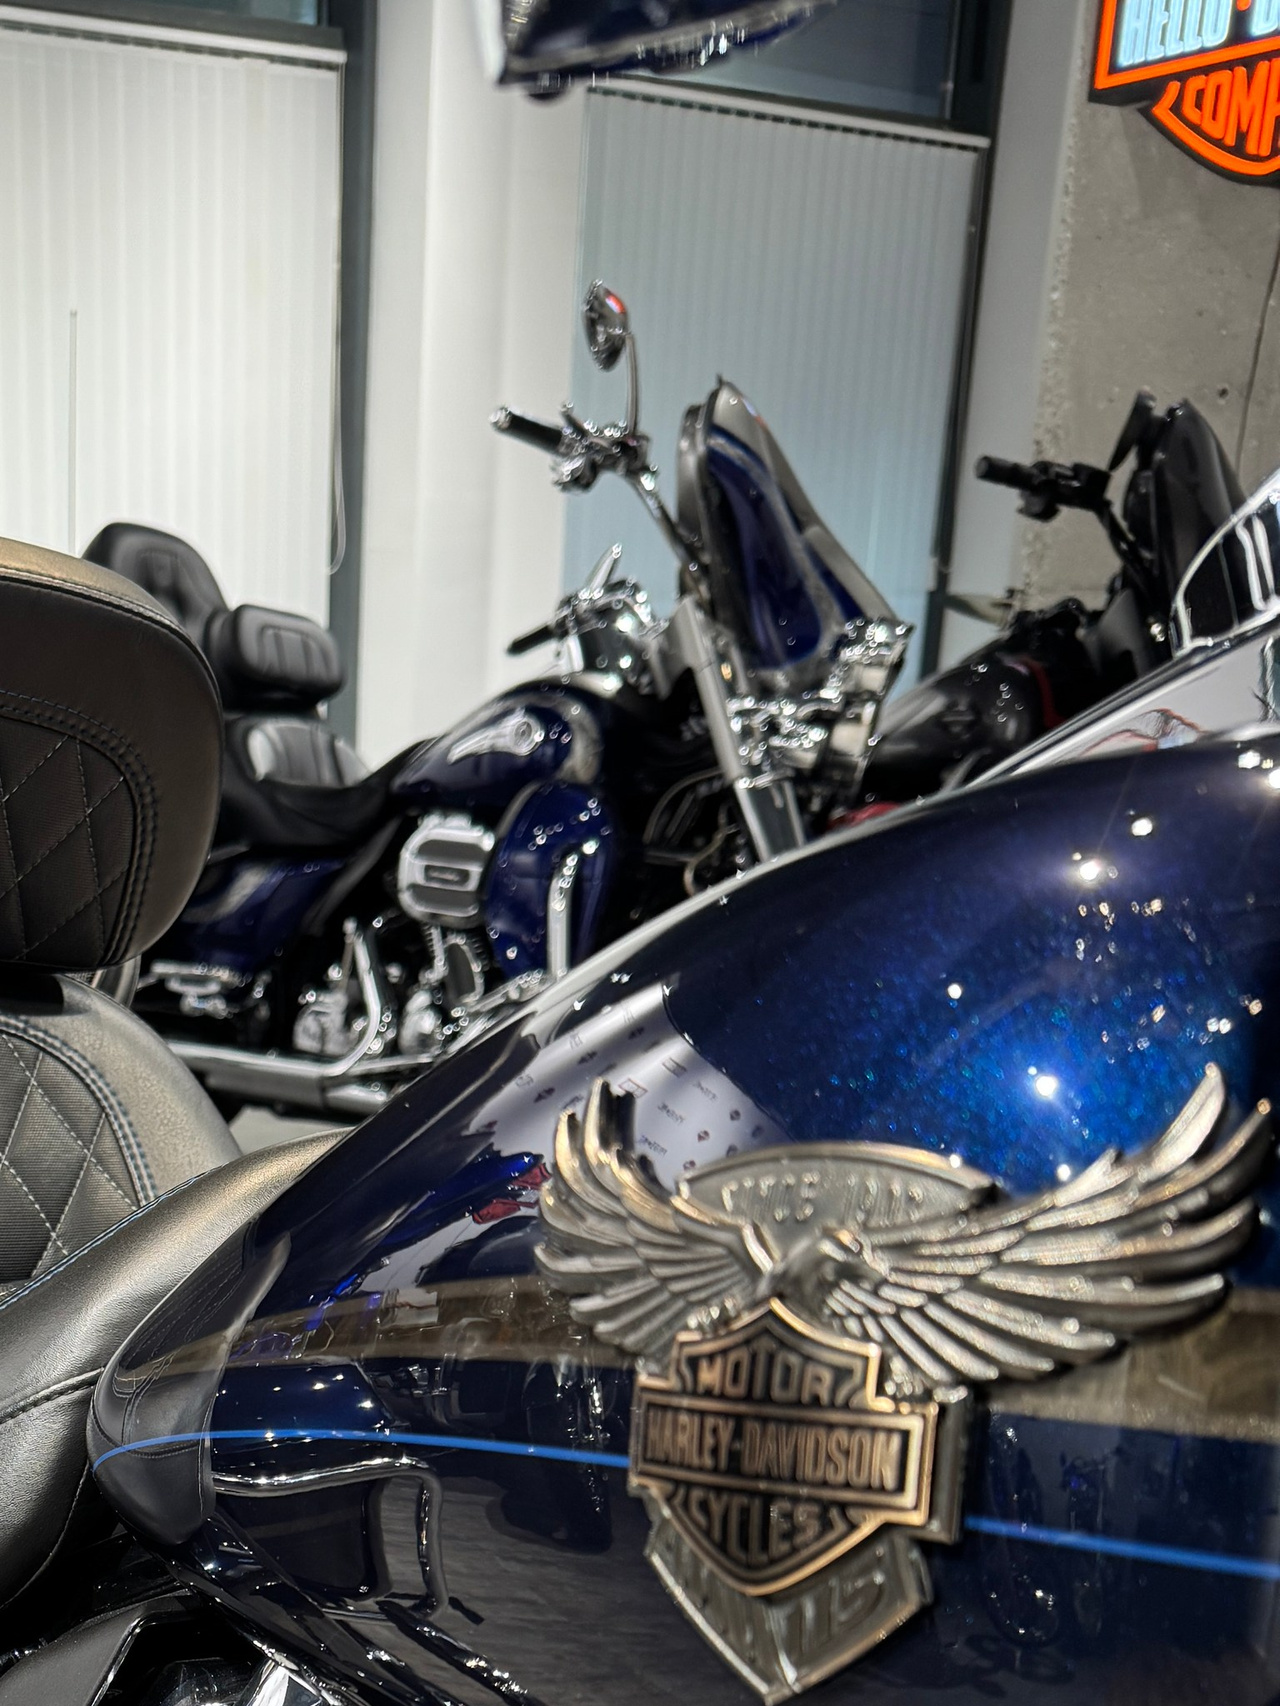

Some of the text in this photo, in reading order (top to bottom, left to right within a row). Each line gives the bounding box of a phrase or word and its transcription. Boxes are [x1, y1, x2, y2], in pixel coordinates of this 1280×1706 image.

[1181, 57, 1280, 158] COMP
[696, 1335, 834, 1406] MOTOR
[645, 1406, 903, 1491] HARLEY-DAVIDSON
[688, 1487, 821, 1565] CYCLES
